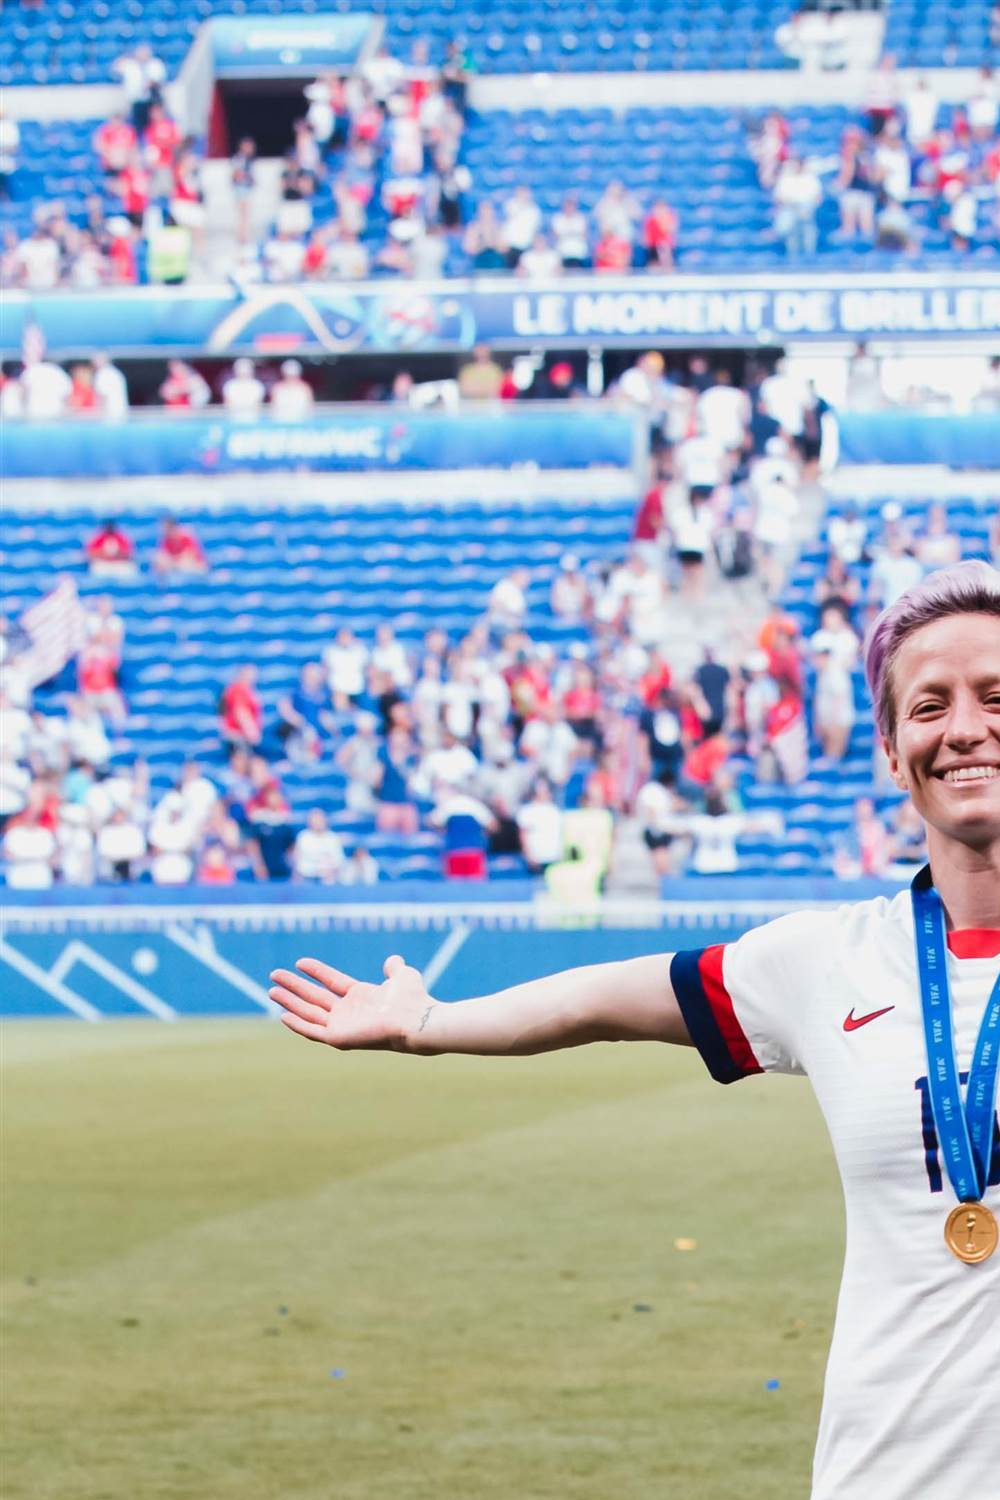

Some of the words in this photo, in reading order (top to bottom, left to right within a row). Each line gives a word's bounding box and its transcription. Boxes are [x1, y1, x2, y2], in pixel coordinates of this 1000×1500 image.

[514, 294, 567, 335] LE
[573, 293, 768, 335] MOMENT
[774, 291, 834, 332] DE
[927, 946, 937, 970] FIFA
[929, 982, 941, 1006] FIFA
[988, 1003, 1000, 1028] FIFA
[932, 1018, 944, 1043] FIFA
[981, 1041, 993, 1067] FIFA
[936, 1056, 948, 1082] FIFA
[975, 1081, 987, 1107] FIFA
[942, 1096, 953, 1122] FIFA
[950, 1136, 961, 1162] FIFA
